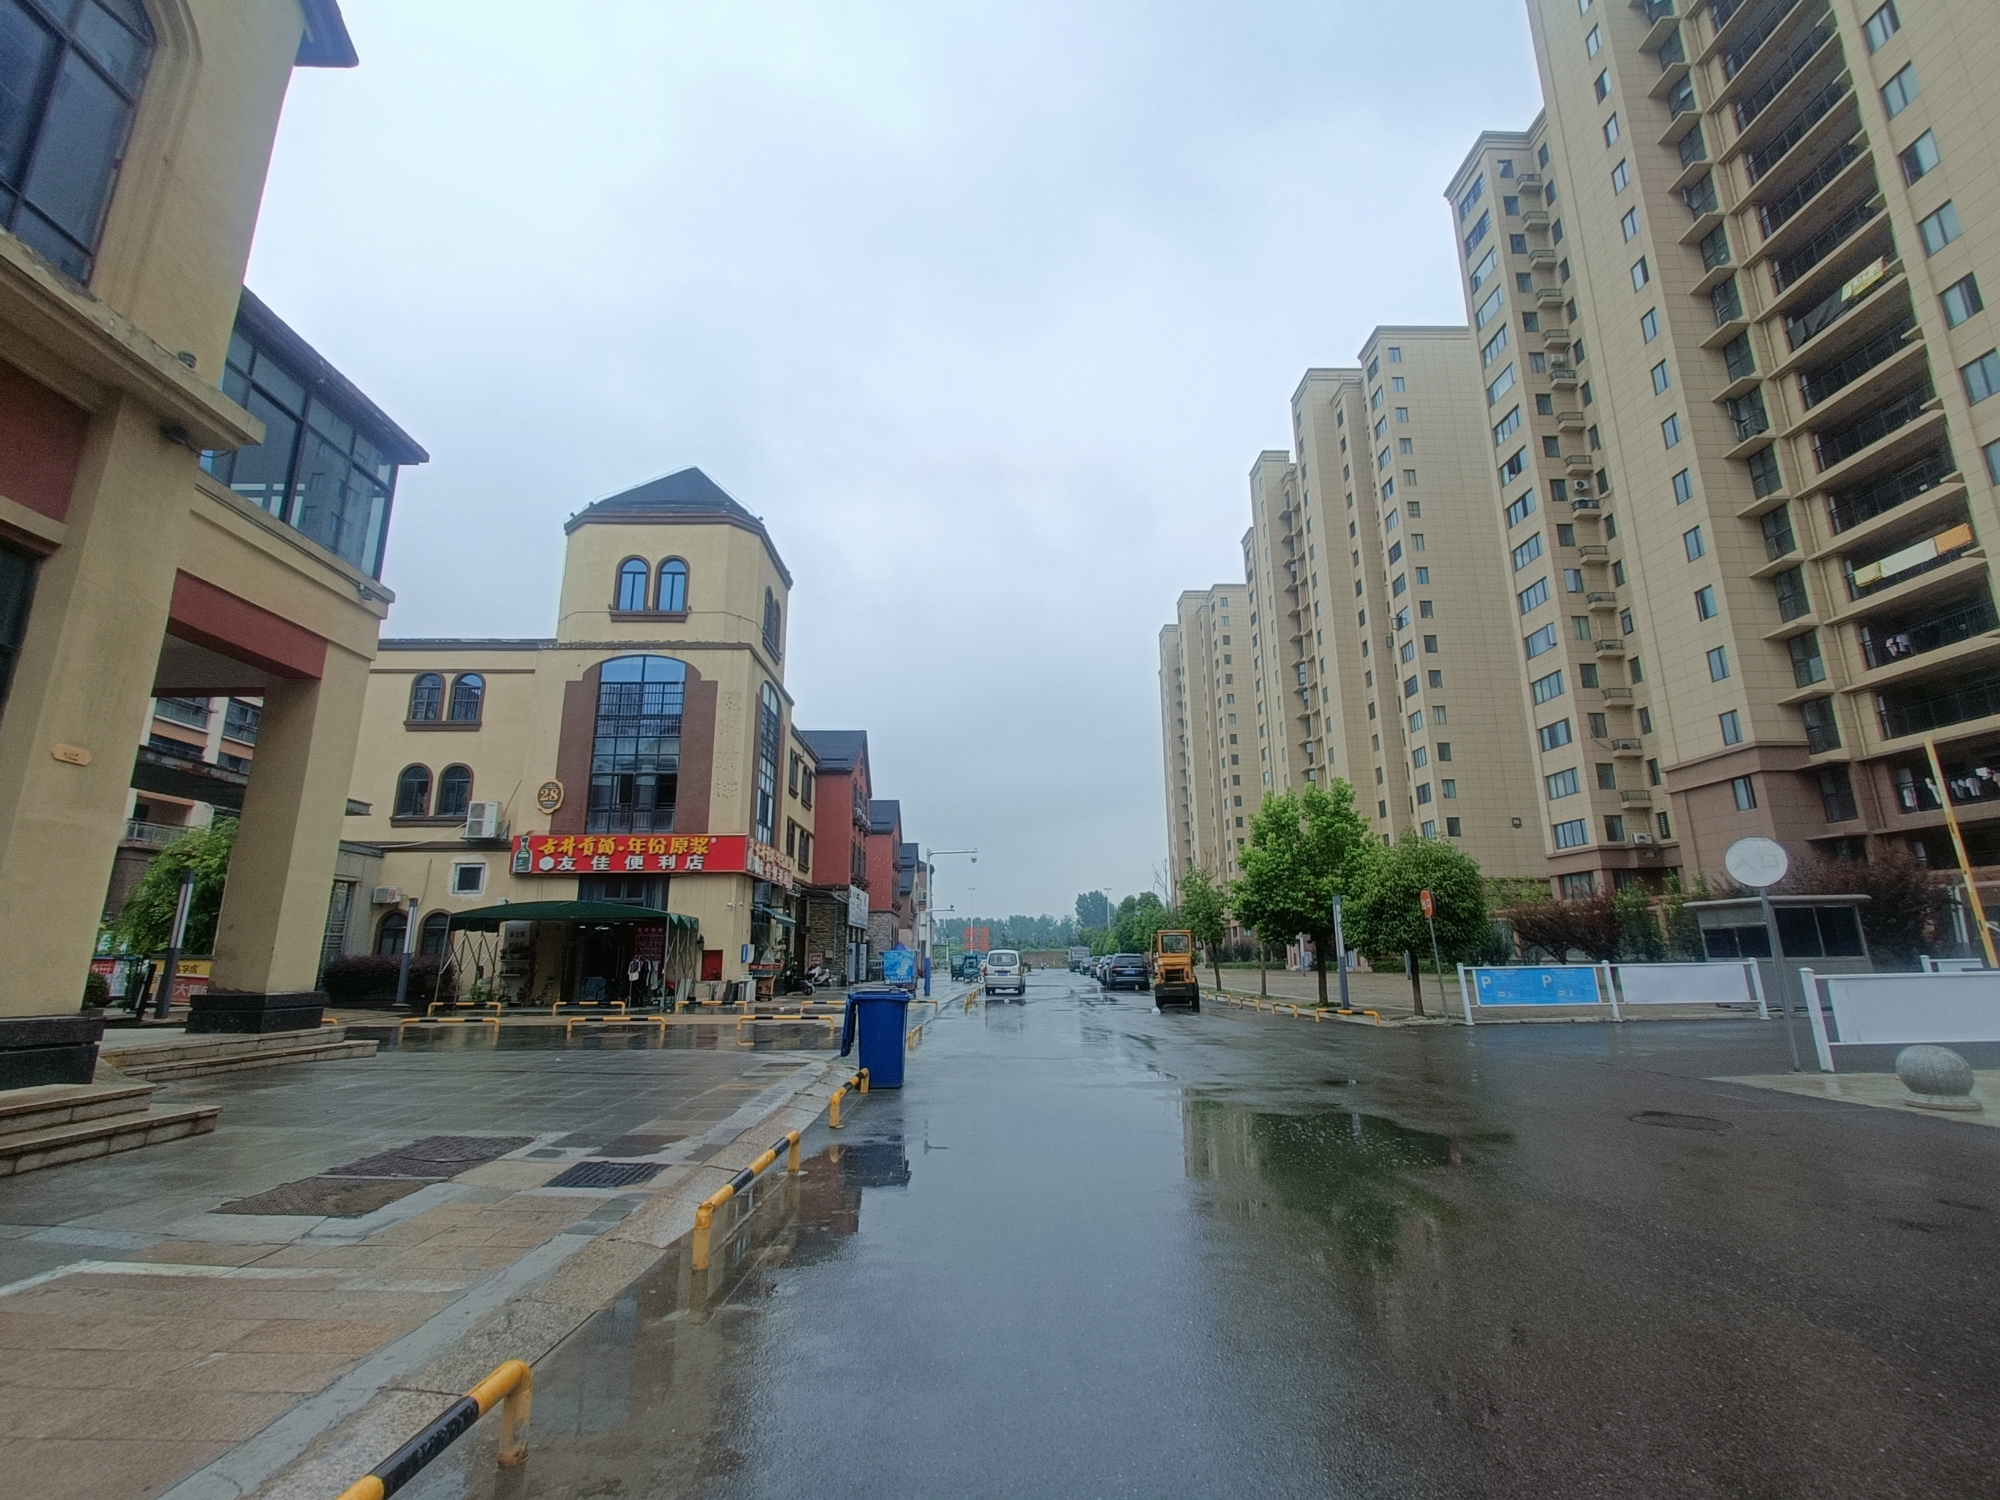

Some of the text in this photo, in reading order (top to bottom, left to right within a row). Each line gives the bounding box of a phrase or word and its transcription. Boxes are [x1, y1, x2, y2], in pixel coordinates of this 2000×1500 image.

[540, 788, 559, 801] 28
[557, 854, 705, 871] 友佳便利店
[1733, 853, 1780, 871] 入口
[1481, 974, 1553, 989] P P
